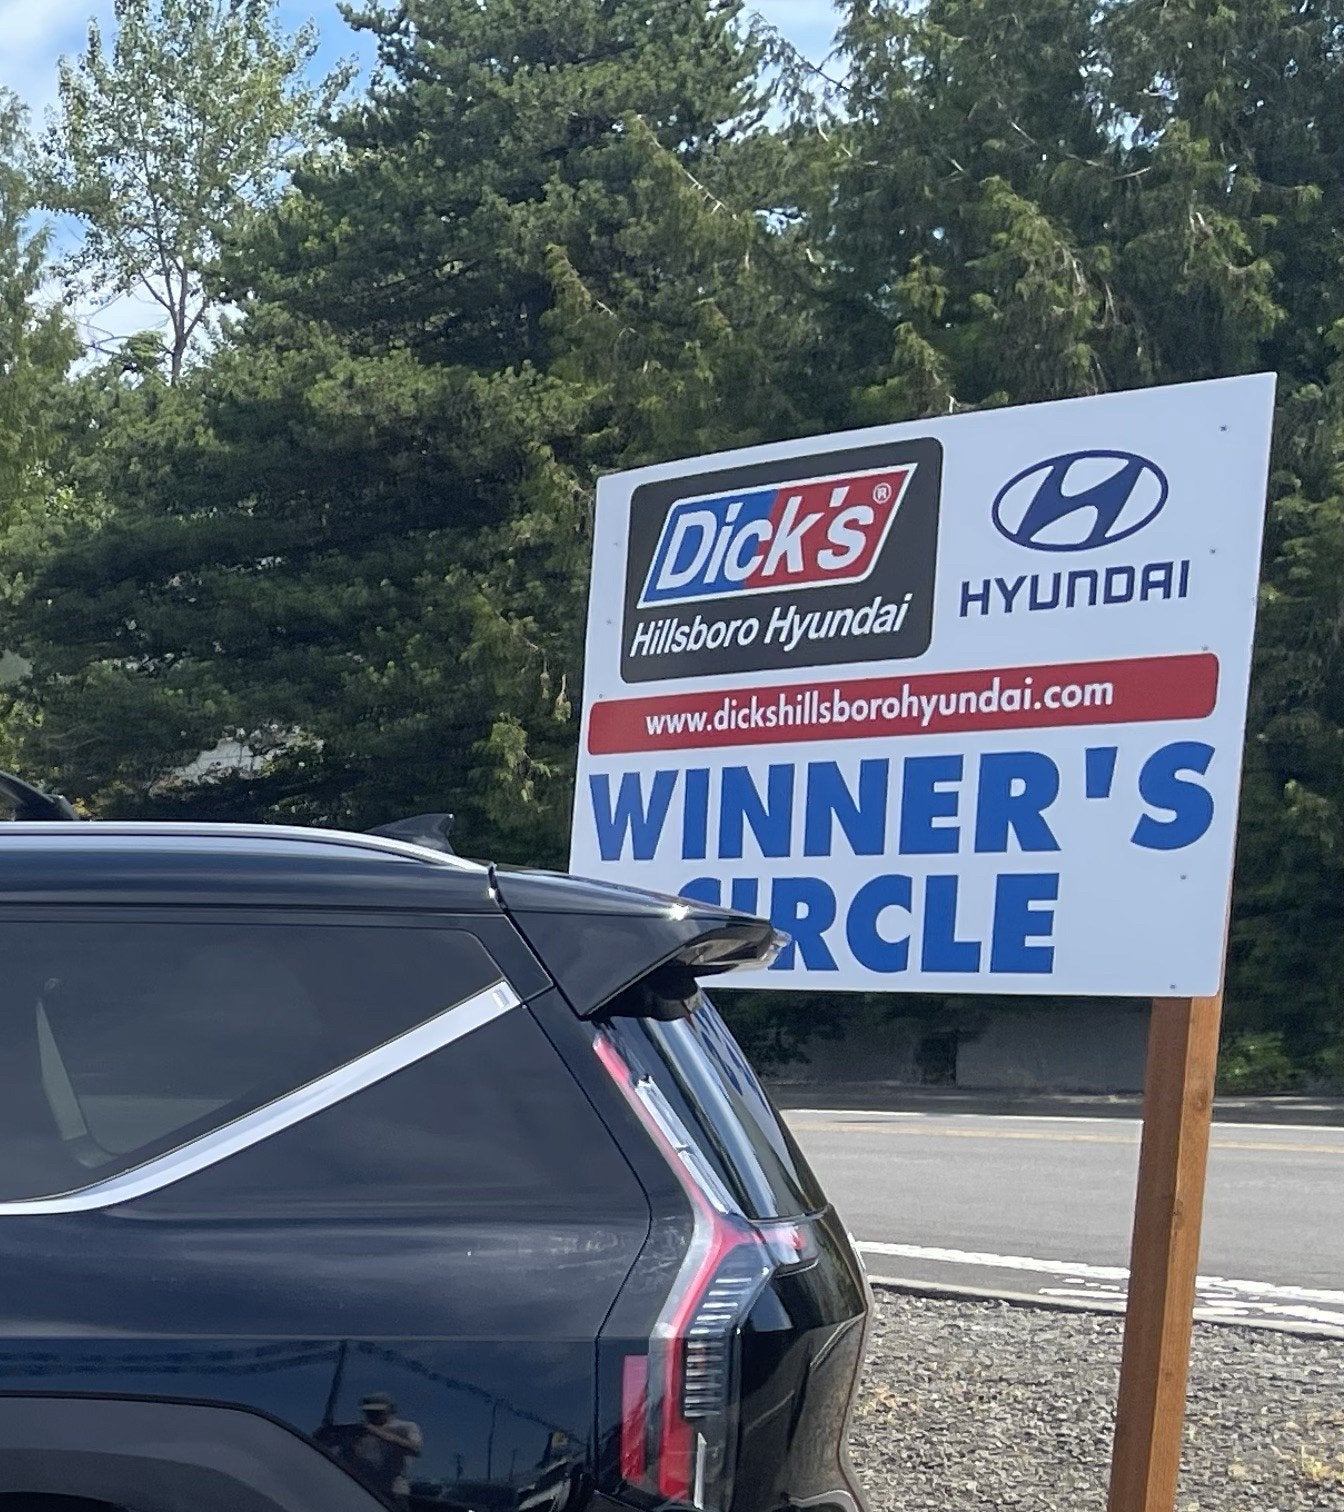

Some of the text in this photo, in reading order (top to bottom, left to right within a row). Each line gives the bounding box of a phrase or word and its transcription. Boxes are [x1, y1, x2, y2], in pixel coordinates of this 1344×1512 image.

[959, 560, 1190, 617] HYUNDAI
[629, 593, 913, 658] Hillsboro Hyundai
[645, 677, 1114, 736] www.dickshillsborohyundai.com
[589, 741, 1216, 862] WINNER'S
[679, 873, 1060, 973] RCLE
